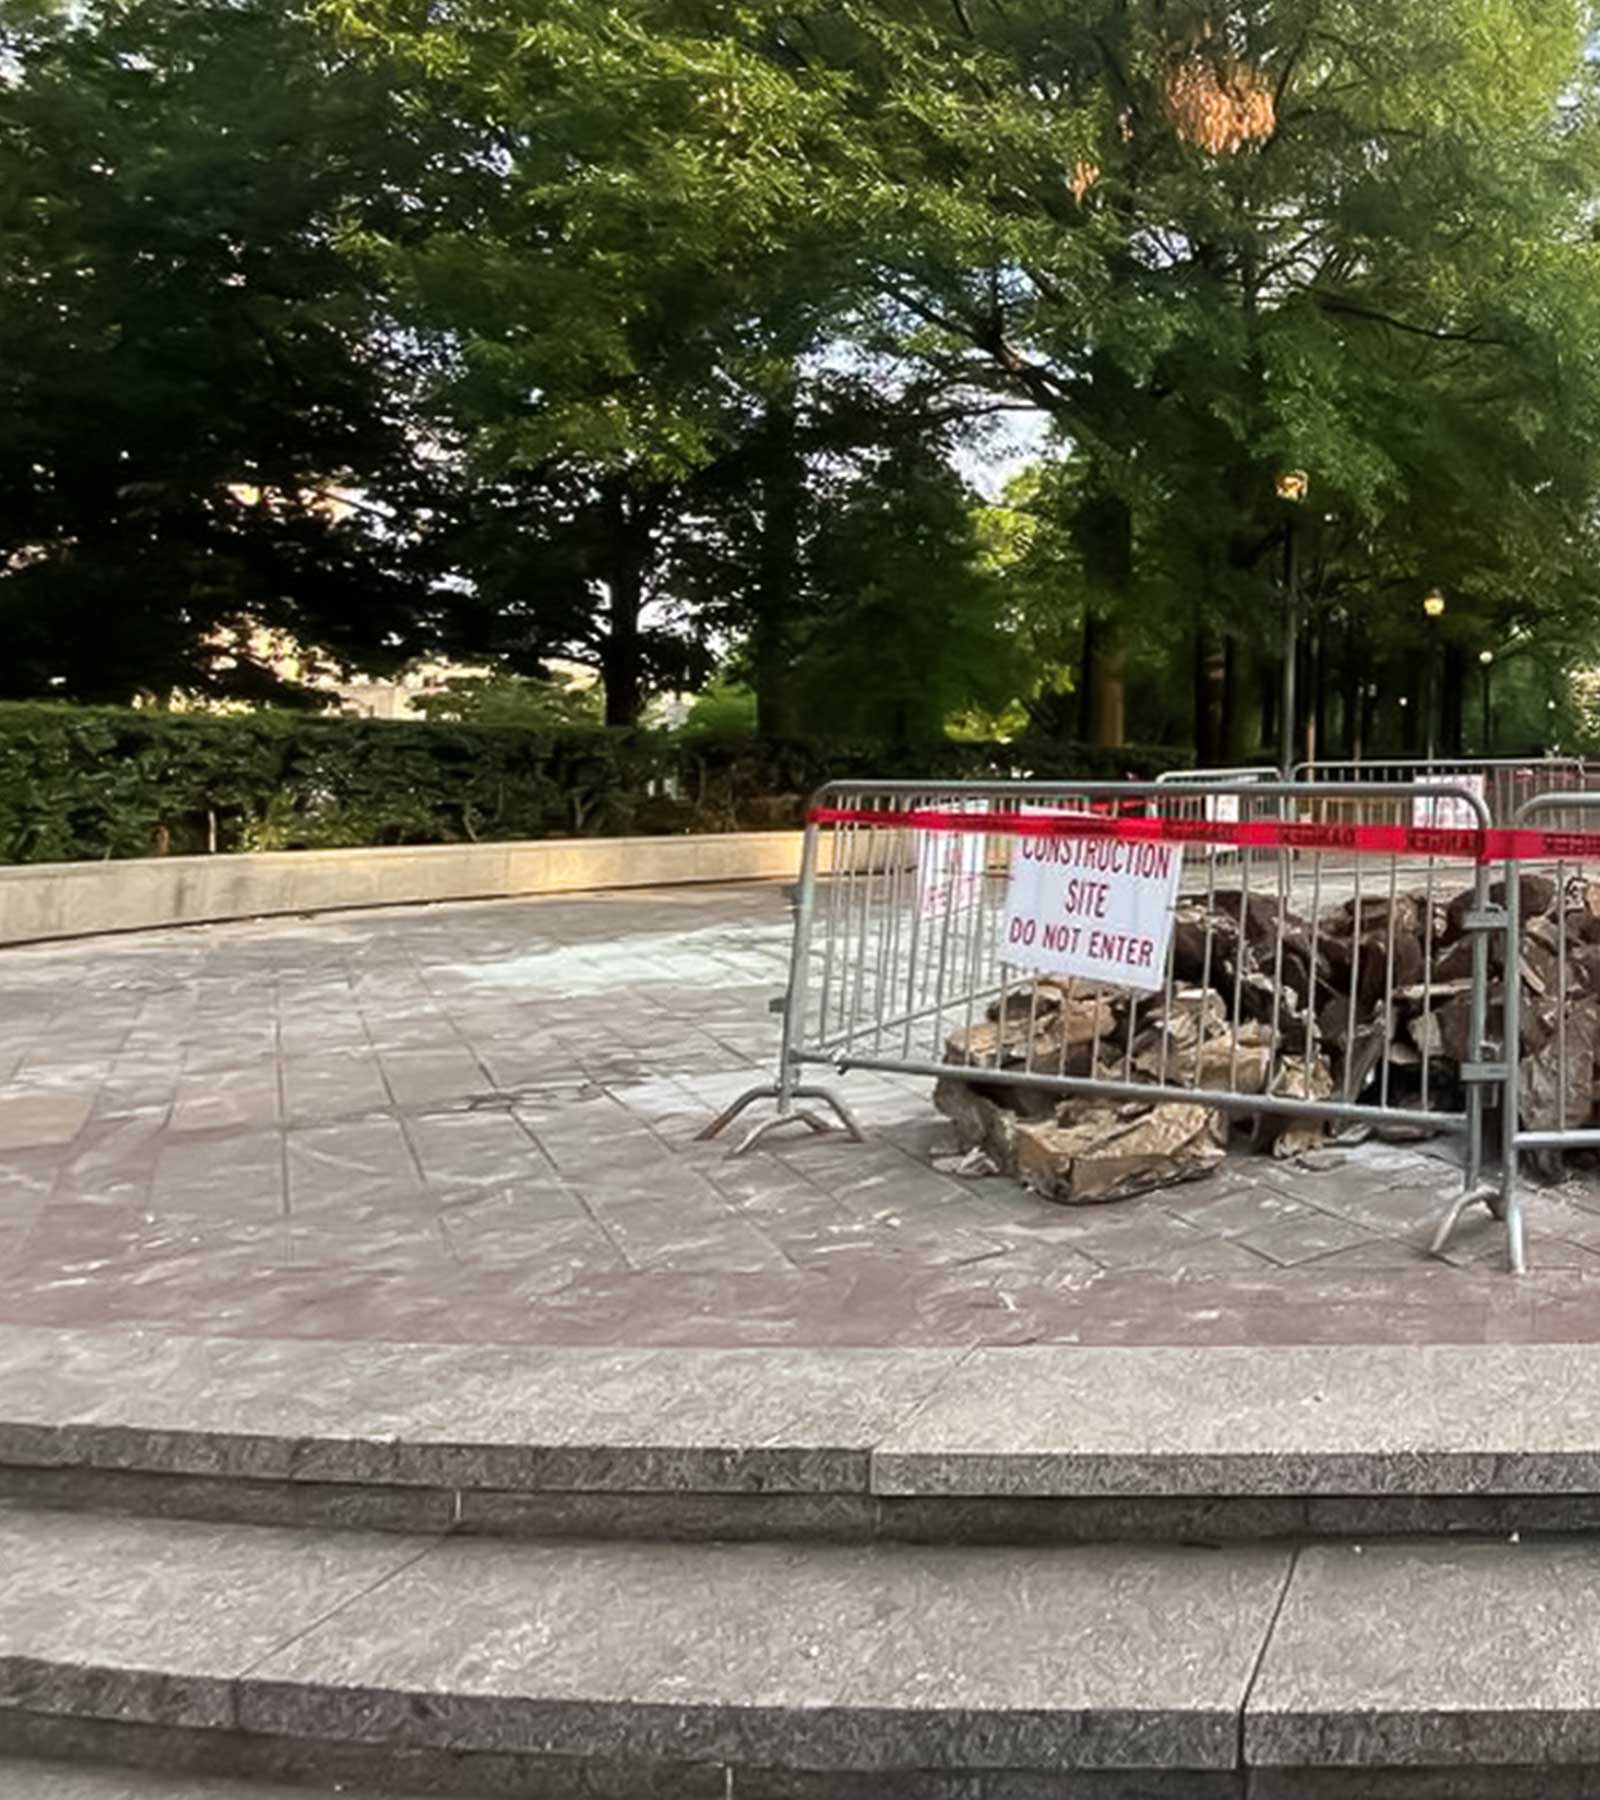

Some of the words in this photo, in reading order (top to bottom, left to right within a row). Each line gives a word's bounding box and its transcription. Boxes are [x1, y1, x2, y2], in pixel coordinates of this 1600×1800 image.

[1022, 837, 1171, 879] CONSTRUCTION
[1065, 878, 1109, 918] SITE
[1009, 917, 1036, 945] DO
[1042, 924, 1081, 953] NOT
[1088, 931, 1153, 966] ENTER
